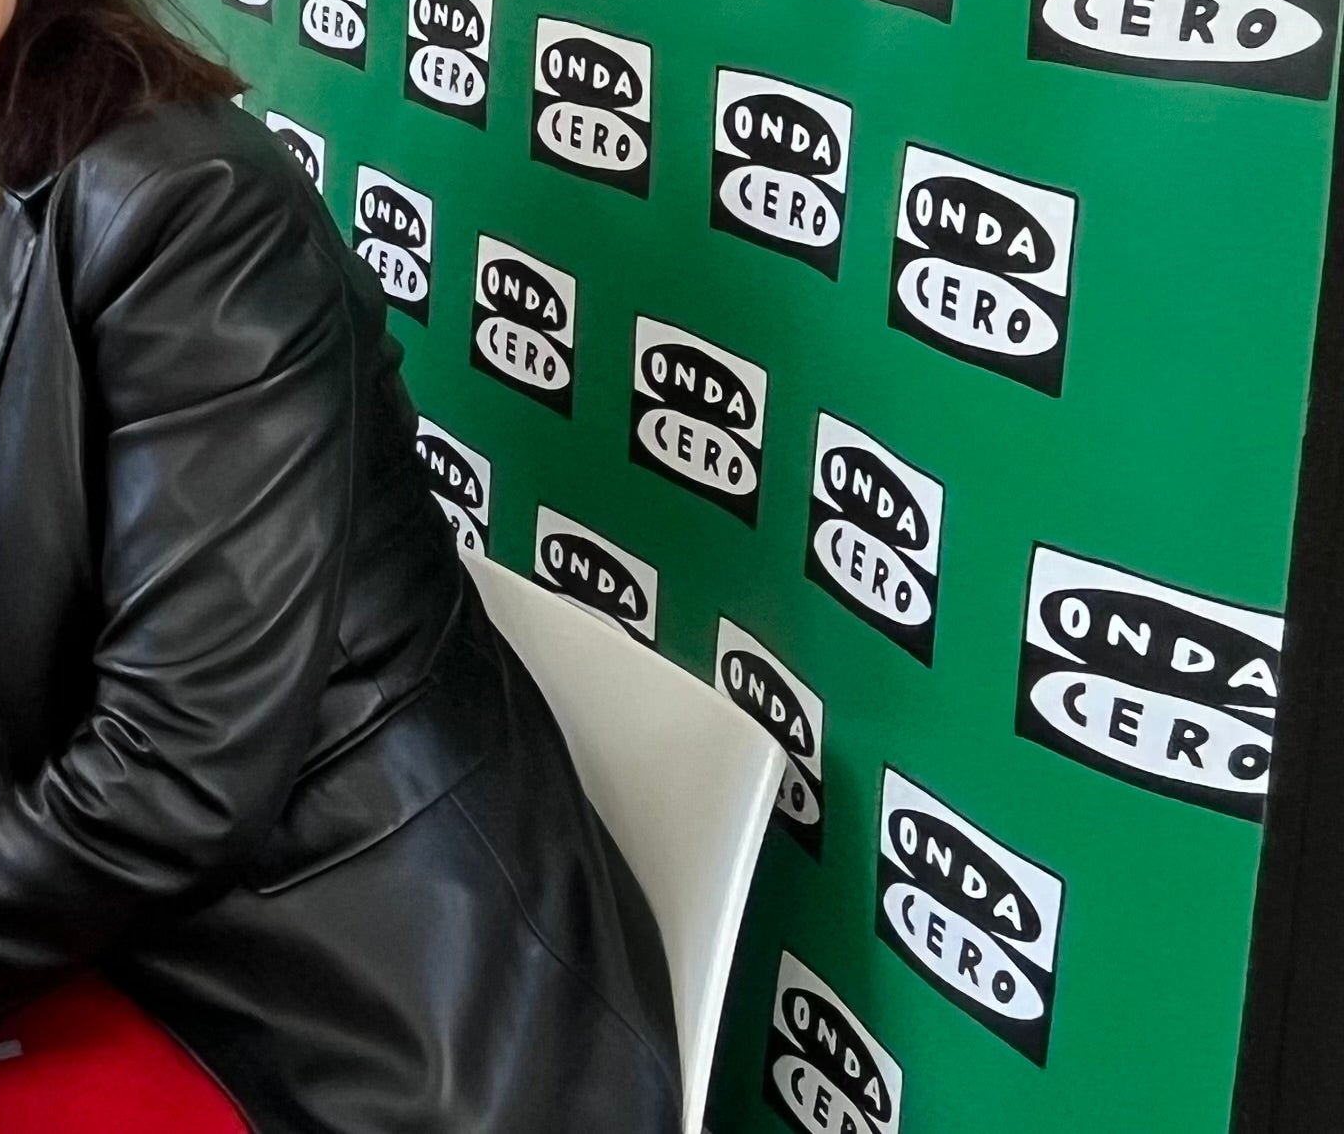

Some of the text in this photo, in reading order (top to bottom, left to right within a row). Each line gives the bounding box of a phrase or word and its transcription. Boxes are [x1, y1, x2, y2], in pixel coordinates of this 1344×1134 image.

[310, 1, 357, 42] CERO
[418, 54, 475, 100] CERO
[548, 54, 633, 100] ONDA
[550, 107, 632, 160] CERO
[733, 104, 833, 167] ONDA
[364, 191, 421, 242] ONDA
[739, 173, 826, 230] CERO
[915, 187, 1037, 264] ONDA
[487, 265, 559, 325] ONDA
[915, 265, 1030, 345] CERO
[488, 322, 558, 383] CERO
[650, 350, 747, 422] ONDA
[653, 415, 744, 486] CERO
[830, 454, 918, 542] ONDA
[548, 539, 638, 616] ONDA
[830, 526, 913, 614] CERO
[1059, 596, 1279, 698] ONDA
[729, 656, 807, 751] ONDA
[1062, 681, 1273, 781] CERO
[898, 815, 1024, 932] ONDA
[901, 893, 1017, 1005] CERO
[792, 997, 881, 1114] ONDA
[789, 1065, 858, 1134] CE
